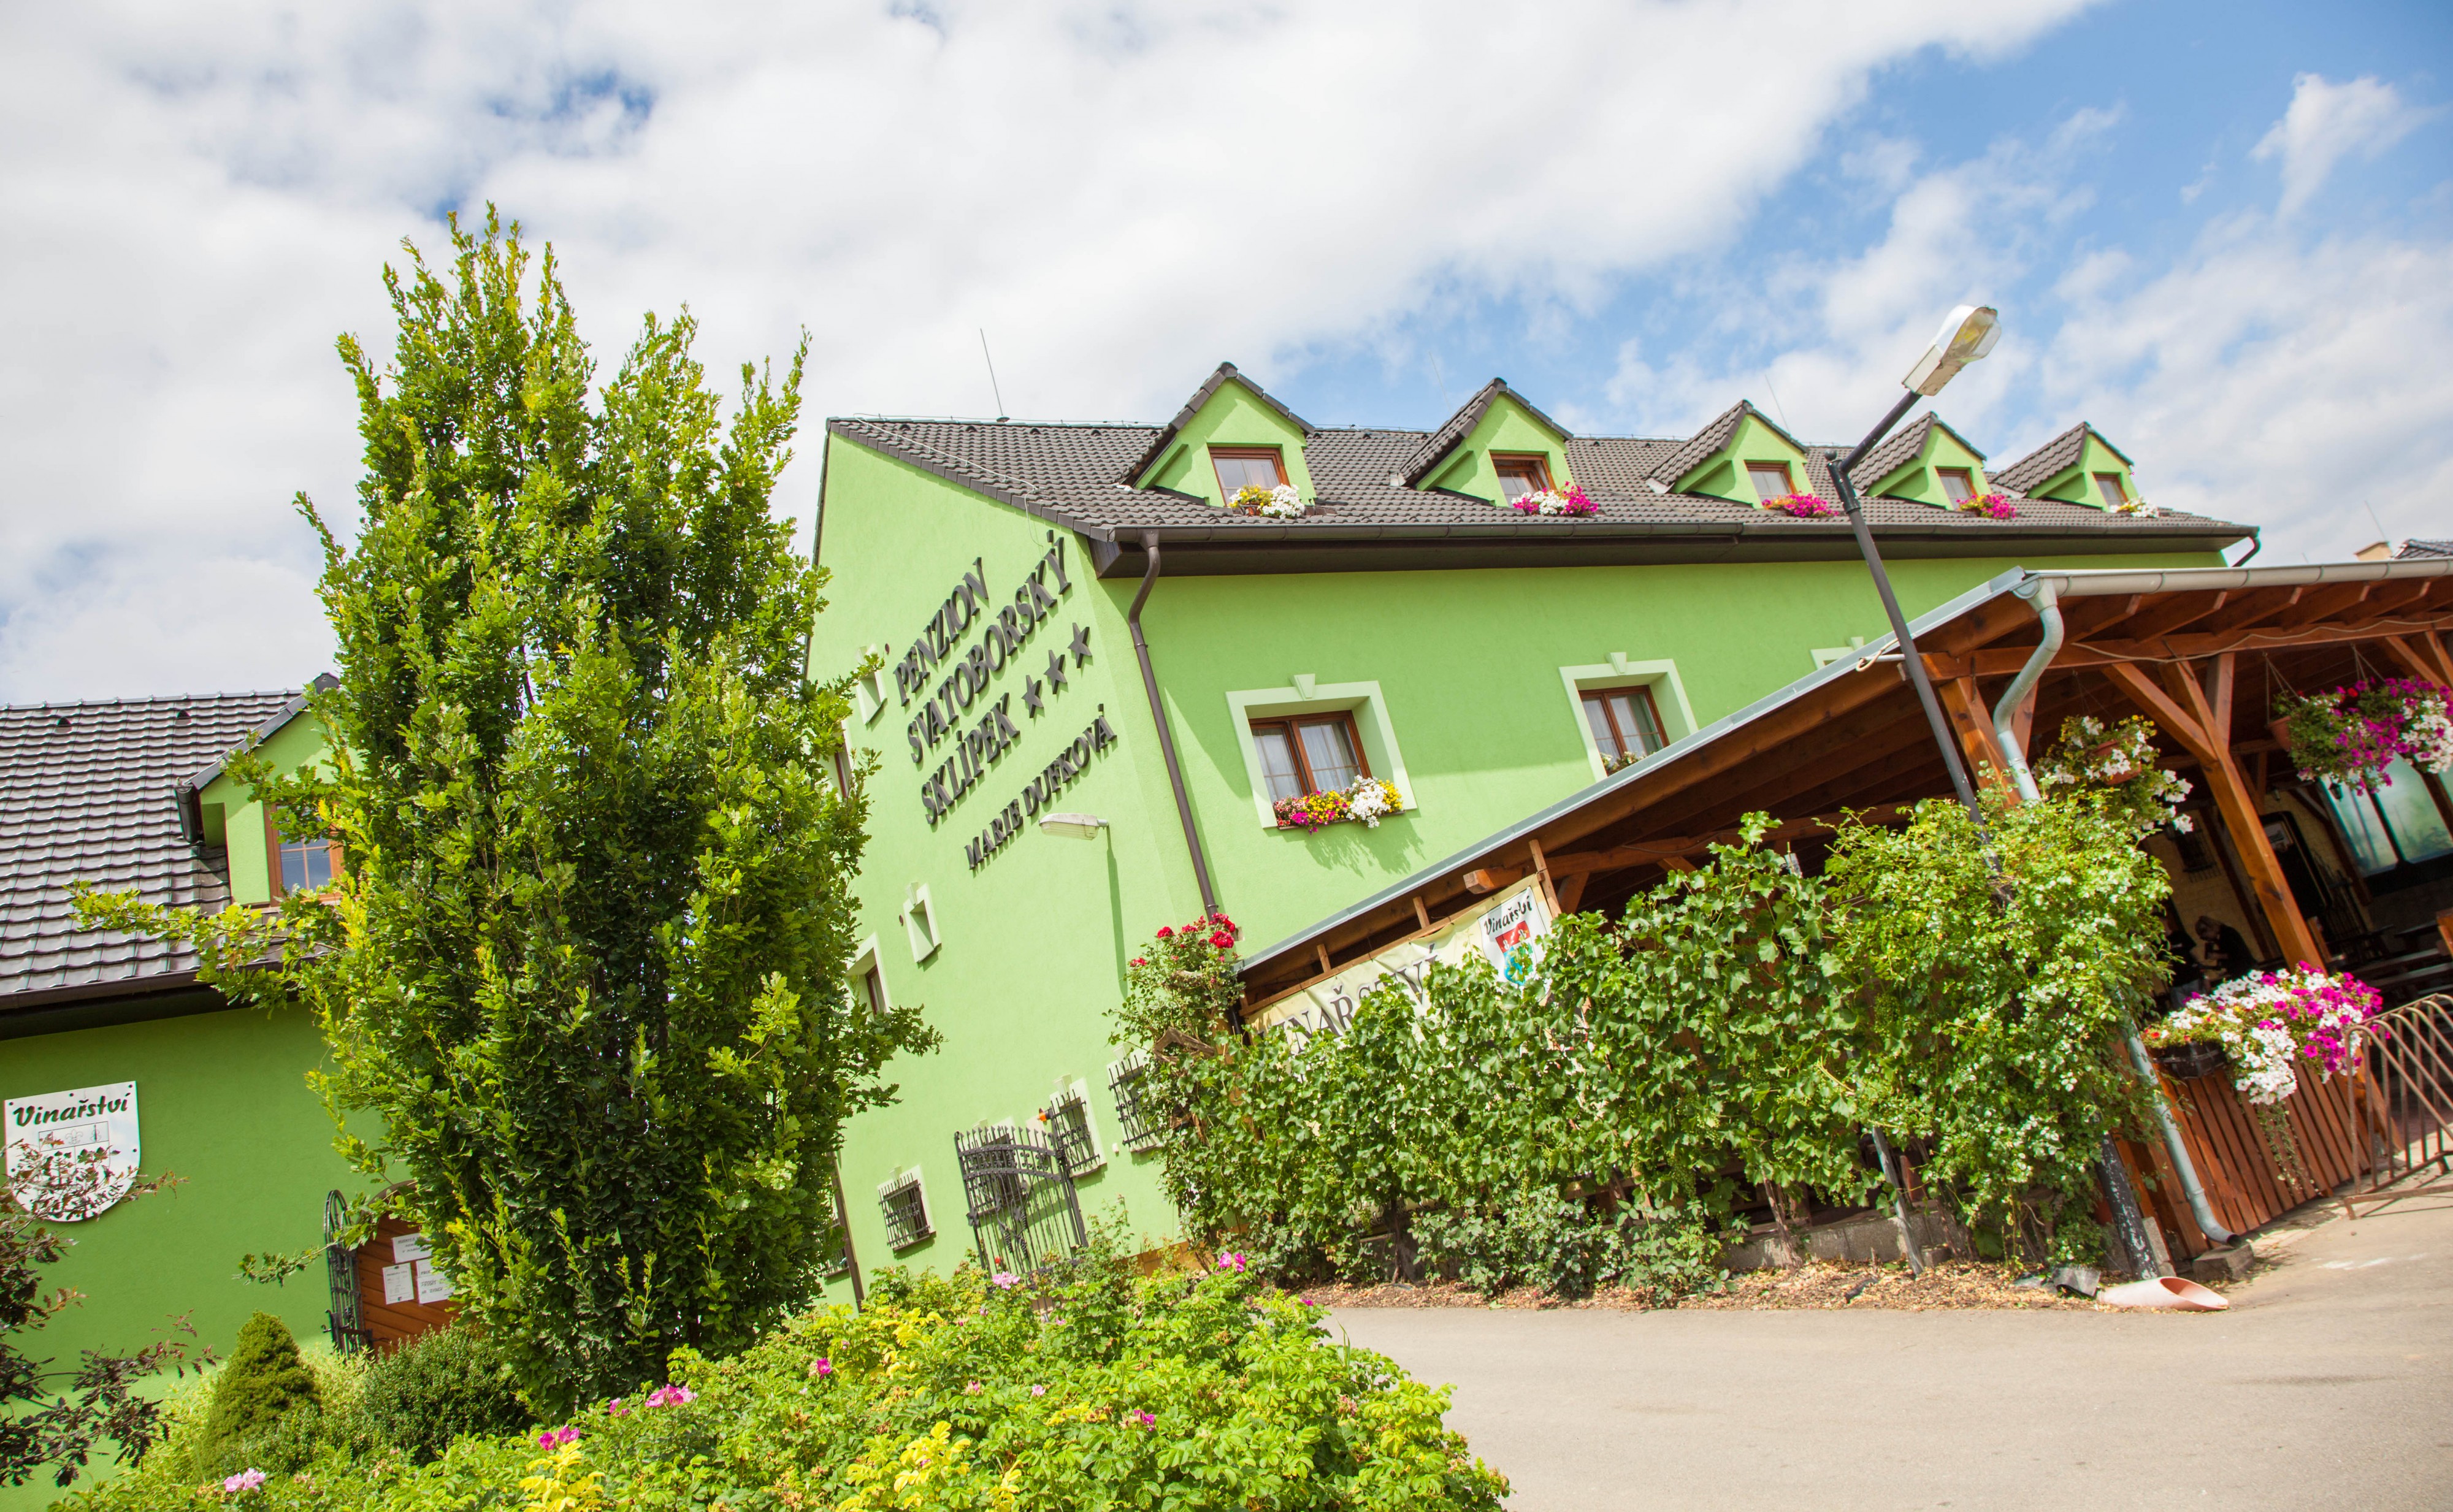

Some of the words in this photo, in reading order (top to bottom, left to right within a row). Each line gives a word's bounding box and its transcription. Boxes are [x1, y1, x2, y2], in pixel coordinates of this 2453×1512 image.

[894, 557, 989, 707] PENZION
[908, 530, 1071, 764] SVATOBORSKÝ
[922, 692, 1020, 826] SKLÍPEK
[965, 799, 1023, 871] MARIE
[1021, 703, 1117, 817] DUFKOVÁ
[1484, 895, 1532, 936] Vinařství
[13, 1093, 131, 1127] Vinařství
